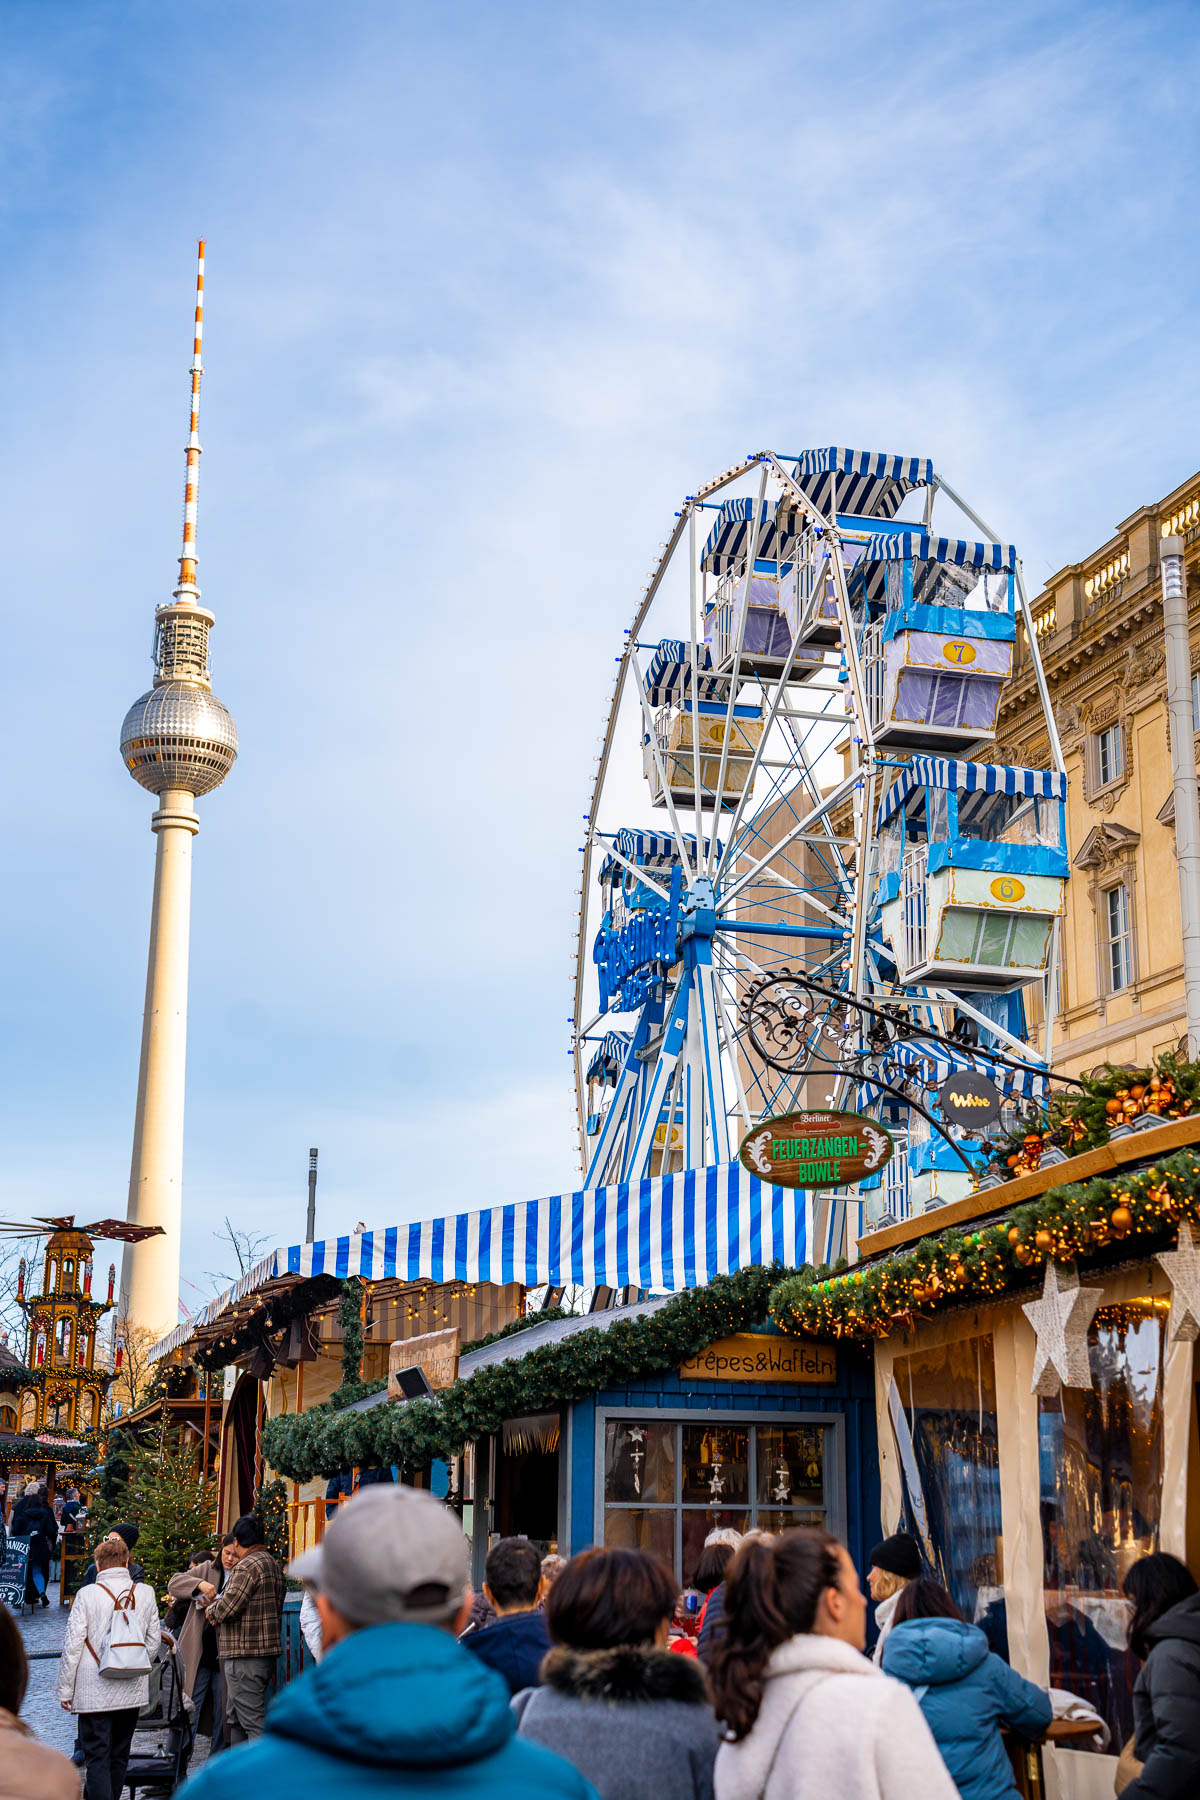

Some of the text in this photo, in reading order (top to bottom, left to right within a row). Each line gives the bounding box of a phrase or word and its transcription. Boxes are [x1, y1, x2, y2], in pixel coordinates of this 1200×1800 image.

[953, 644, 965, 662] 7
[1000, 879, 1014, 899] 6
[801, 1113, 831, 1123] Berliner
[772, 1136, 867, 1160] FEUERZANGEN-
[799, 1161, 841, 1183] BOWLE
[6, 1540, 30, 1556] ANIEL'S
